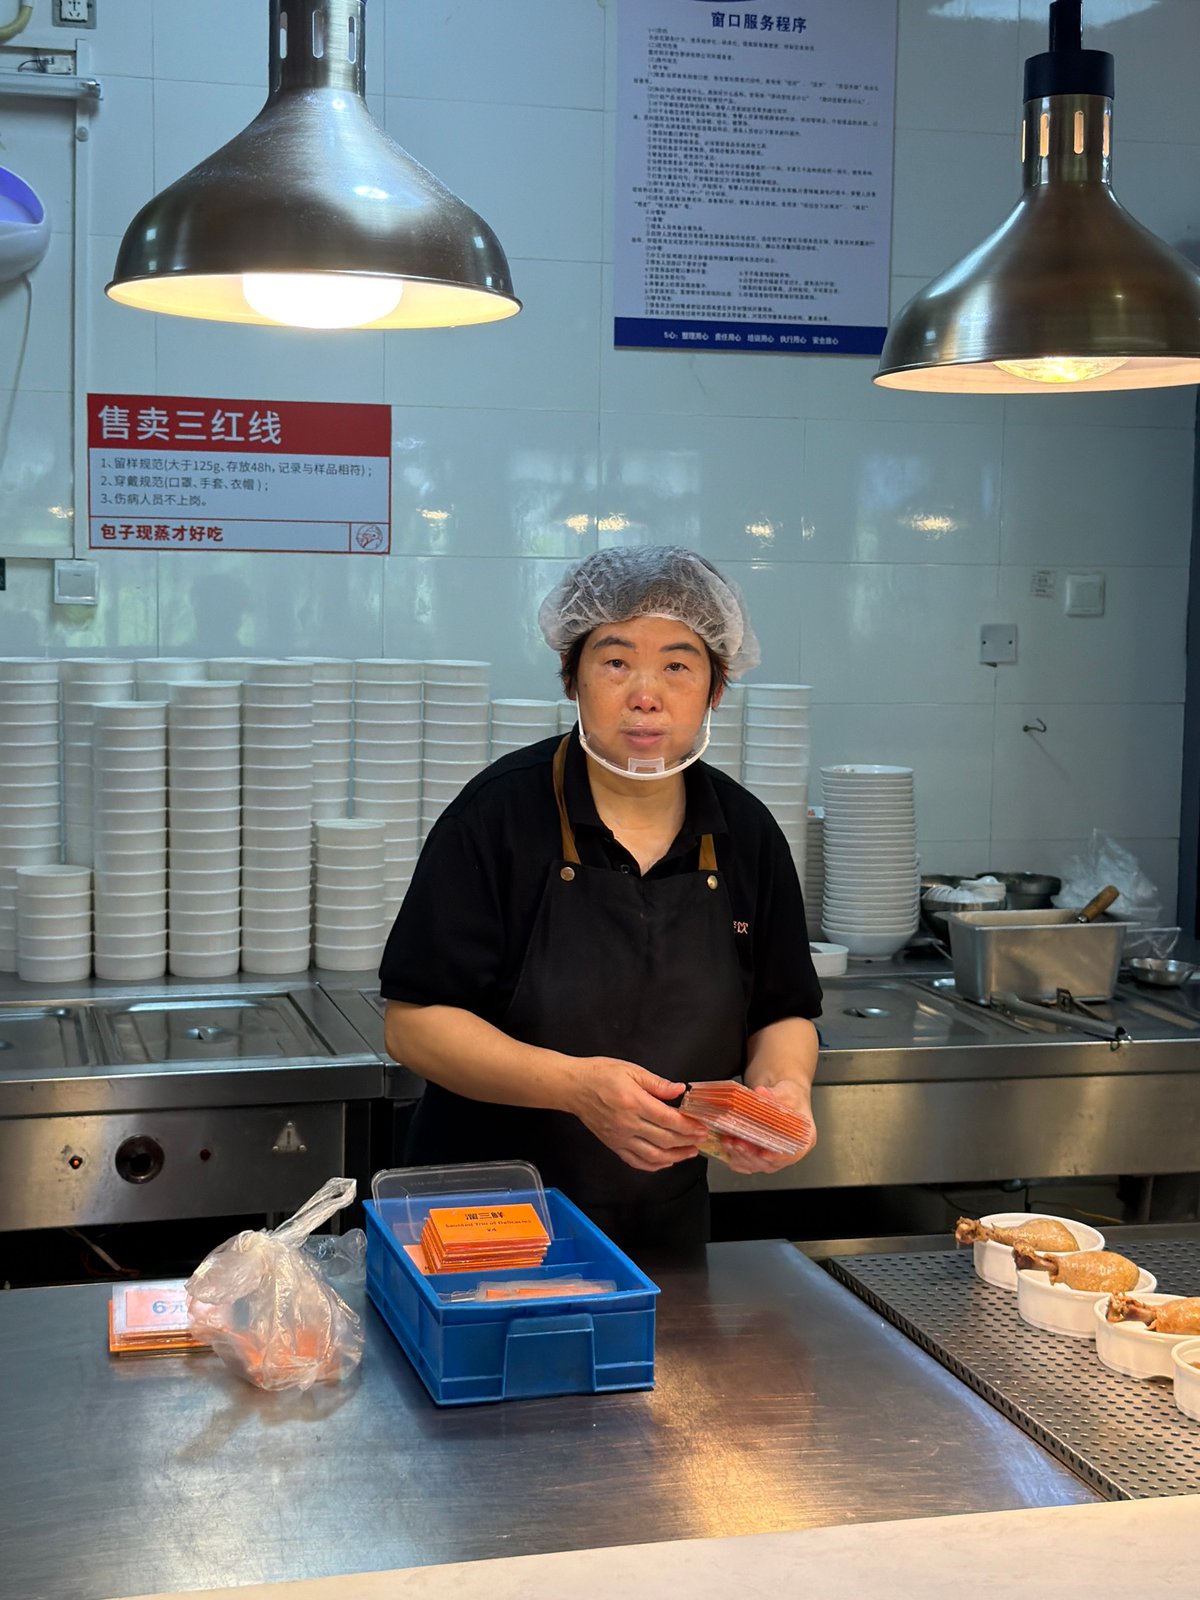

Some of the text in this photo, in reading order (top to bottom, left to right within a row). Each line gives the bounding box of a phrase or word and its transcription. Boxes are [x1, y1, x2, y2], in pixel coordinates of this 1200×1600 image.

[711, 11, 807, 33] 窗口服务程序
[98, 405, 282, 445] 售卖三红线
[101, 524, 224, 542] 包子现蒸才好吃
[733, 920, 749, 935] 饮
